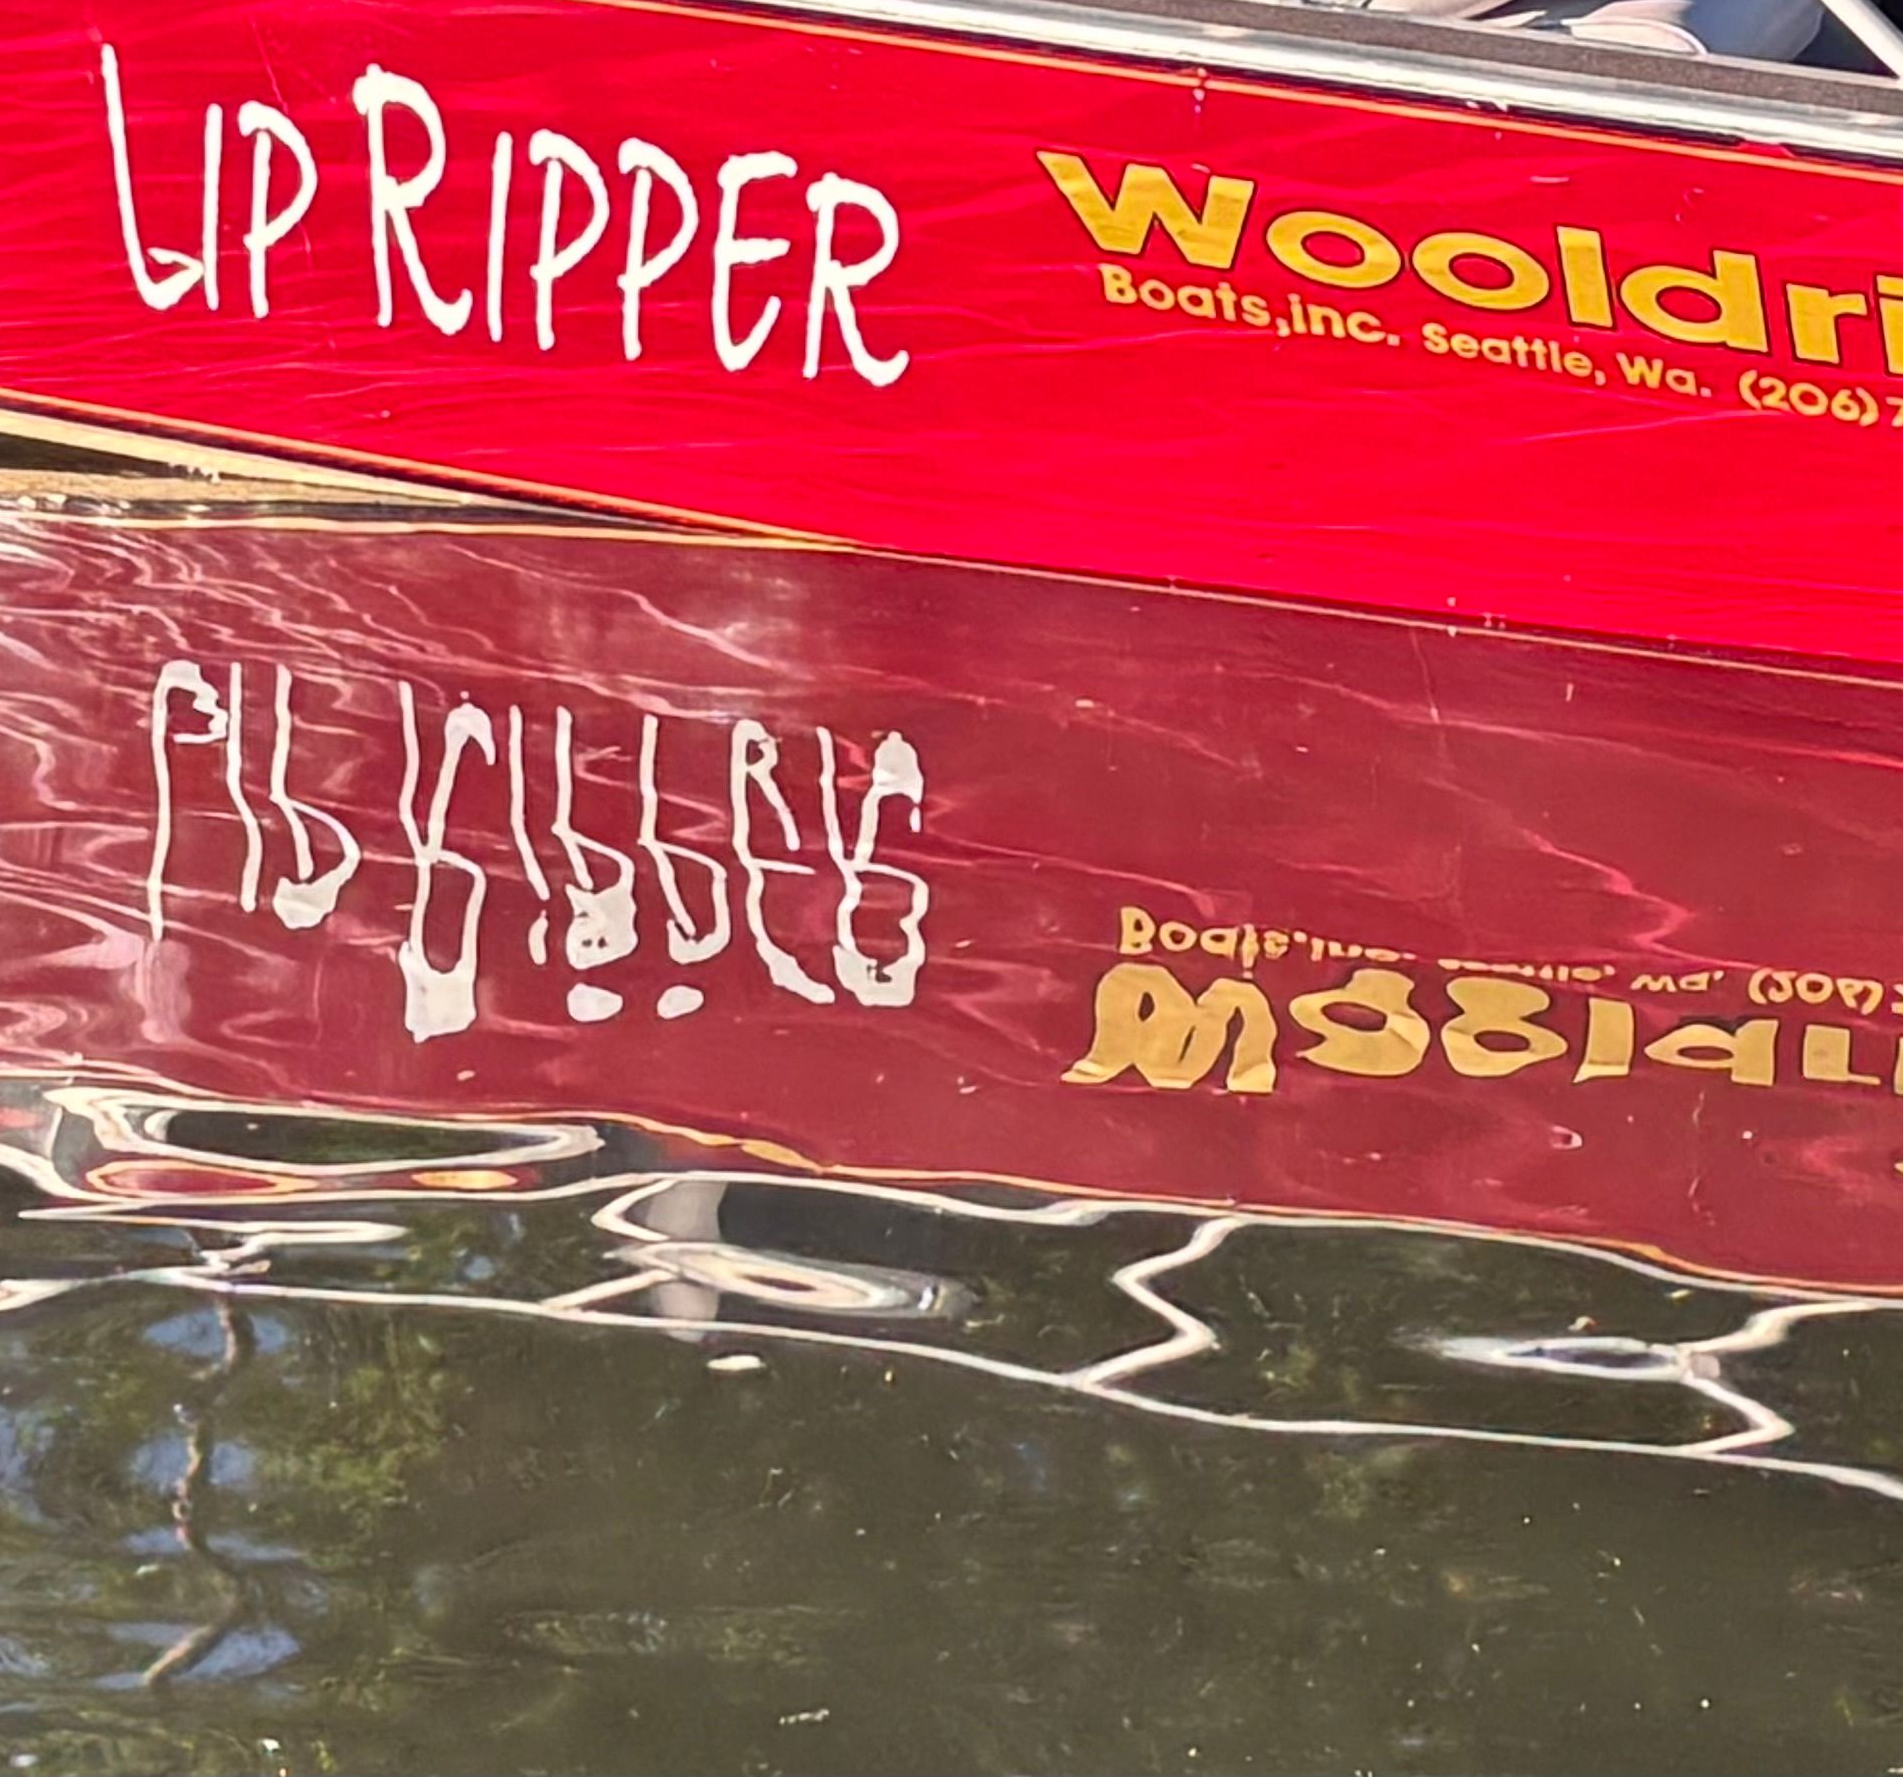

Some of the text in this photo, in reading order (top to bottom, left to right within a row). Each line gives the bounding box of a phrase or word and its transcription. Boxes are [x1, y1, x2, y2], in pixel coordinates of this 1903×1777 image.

[101, 43, 909, 387] LIP RIPPER
[1422, 323, 1606, 386] Seattle,
[1616, 352, 1711, 398] Wa.
[1739, 369, 1878, 427] (206)
